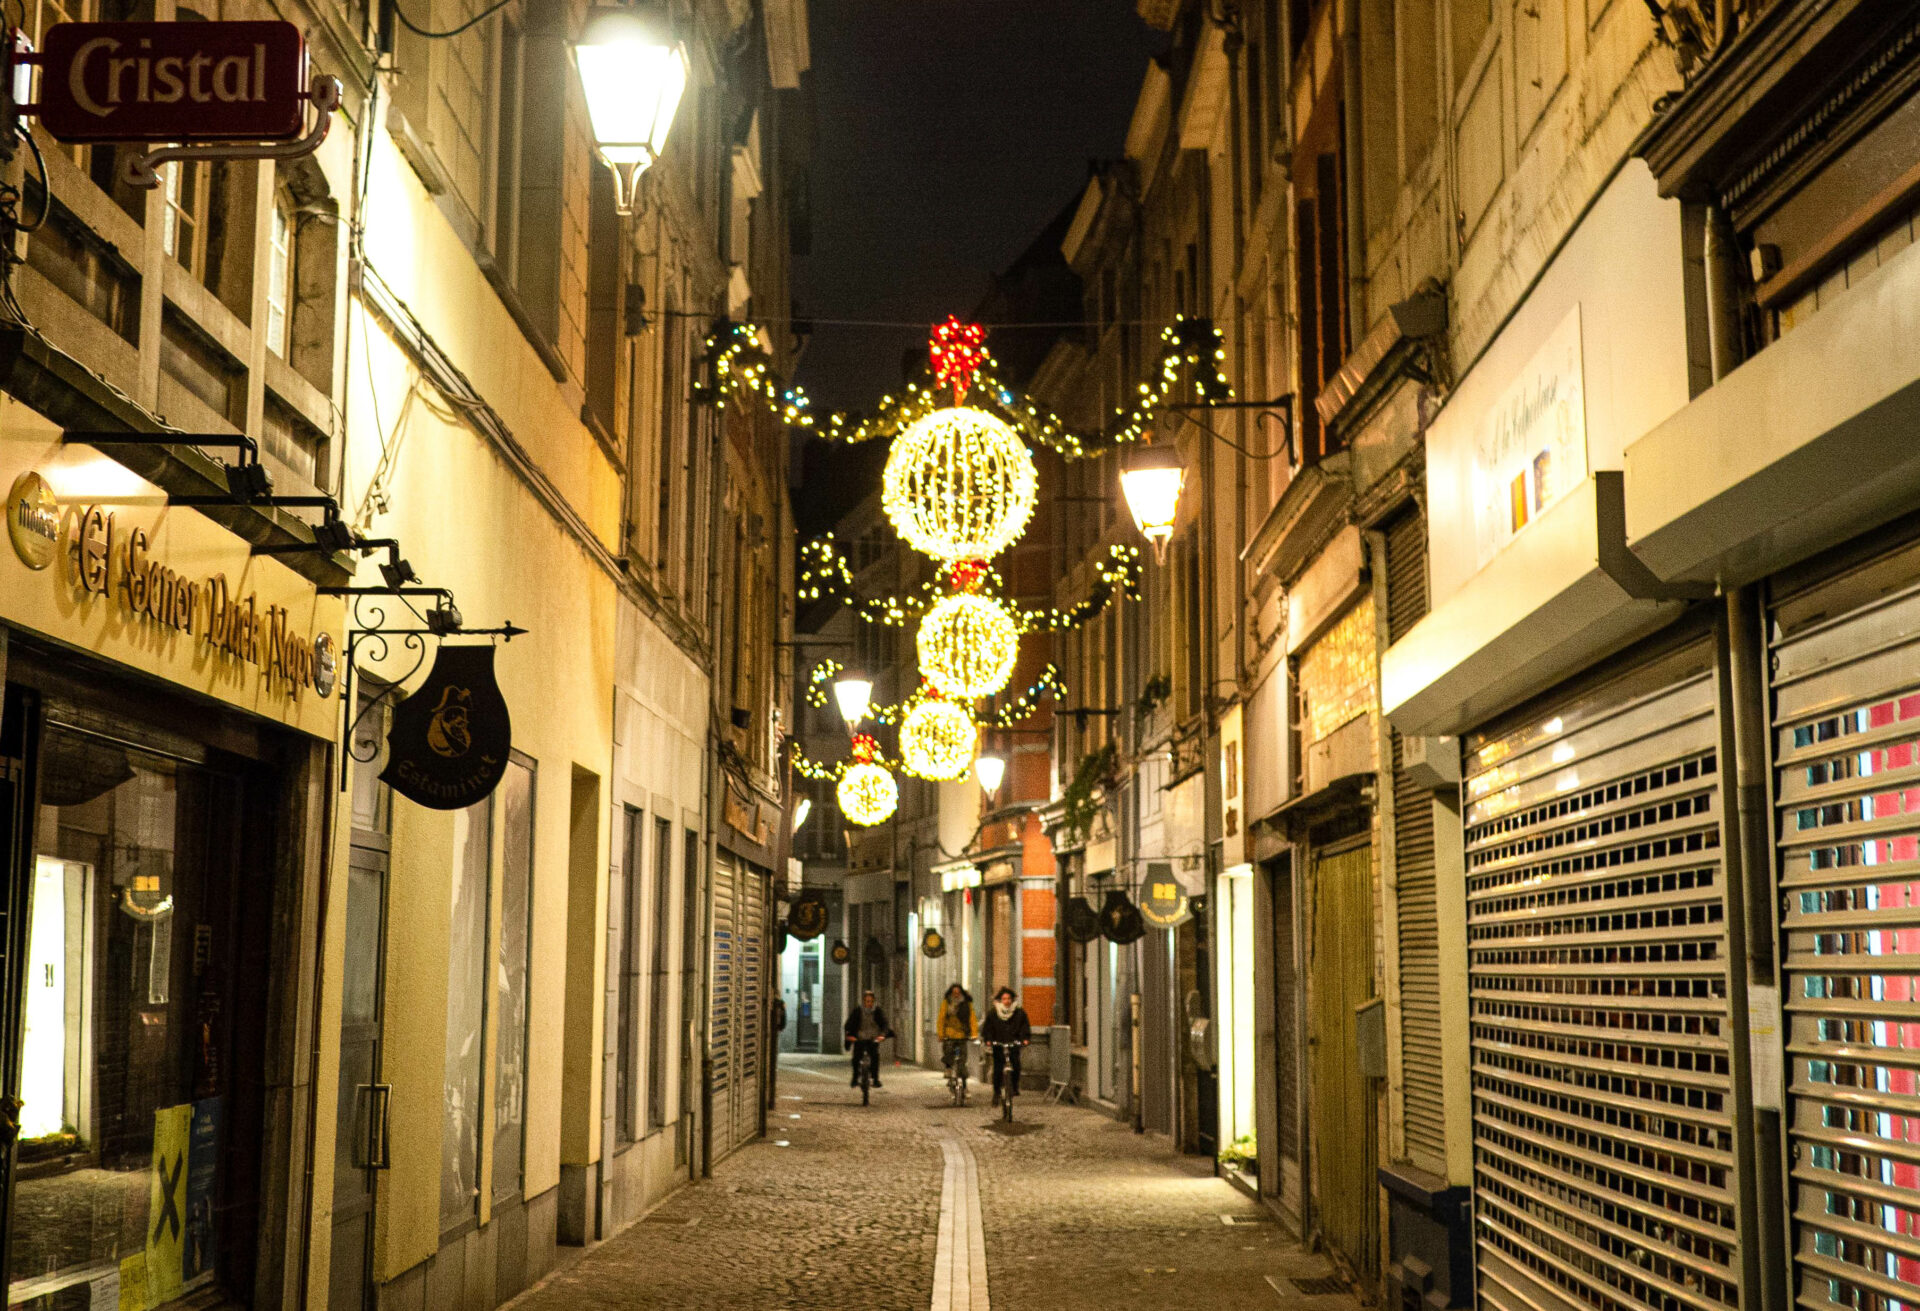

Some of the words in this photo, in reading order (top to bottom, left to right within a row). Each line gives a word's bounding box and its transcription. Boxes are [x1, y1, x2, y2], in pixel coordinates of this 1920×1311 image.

[68, 37, 267, 117] Cristal
[79, 503, 115, 598] El
[207, 572, 260, 665] Duck
[266, 604, 315, 702] Napo
[398, 754, 497, 798] Estaminet
